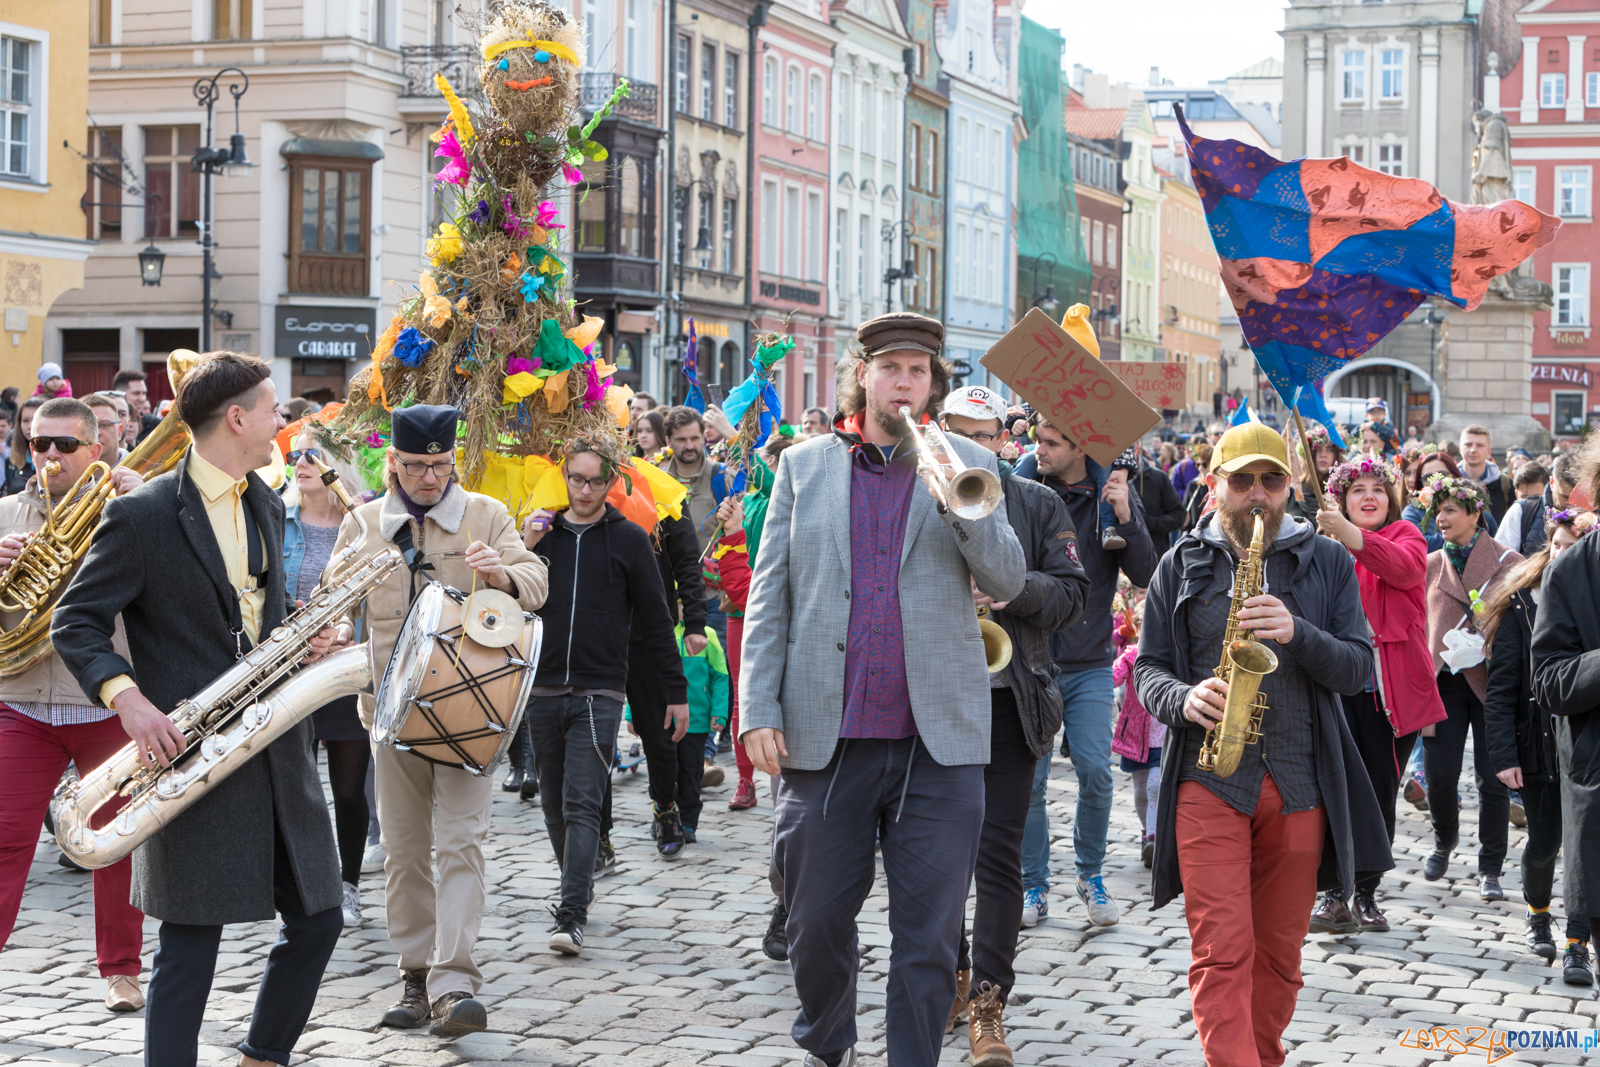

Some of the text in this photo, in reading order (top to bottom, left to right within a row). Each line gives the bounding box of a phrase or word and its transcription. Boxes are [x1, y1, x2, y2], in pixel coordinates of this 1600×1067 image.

[1556, 332, 1584, 344] idea
[298, 340, 357, 357] CABARET
[1031, 325, 1116, 401] ZIMO
[1134, 379, 1183, 392] WIOSNO
